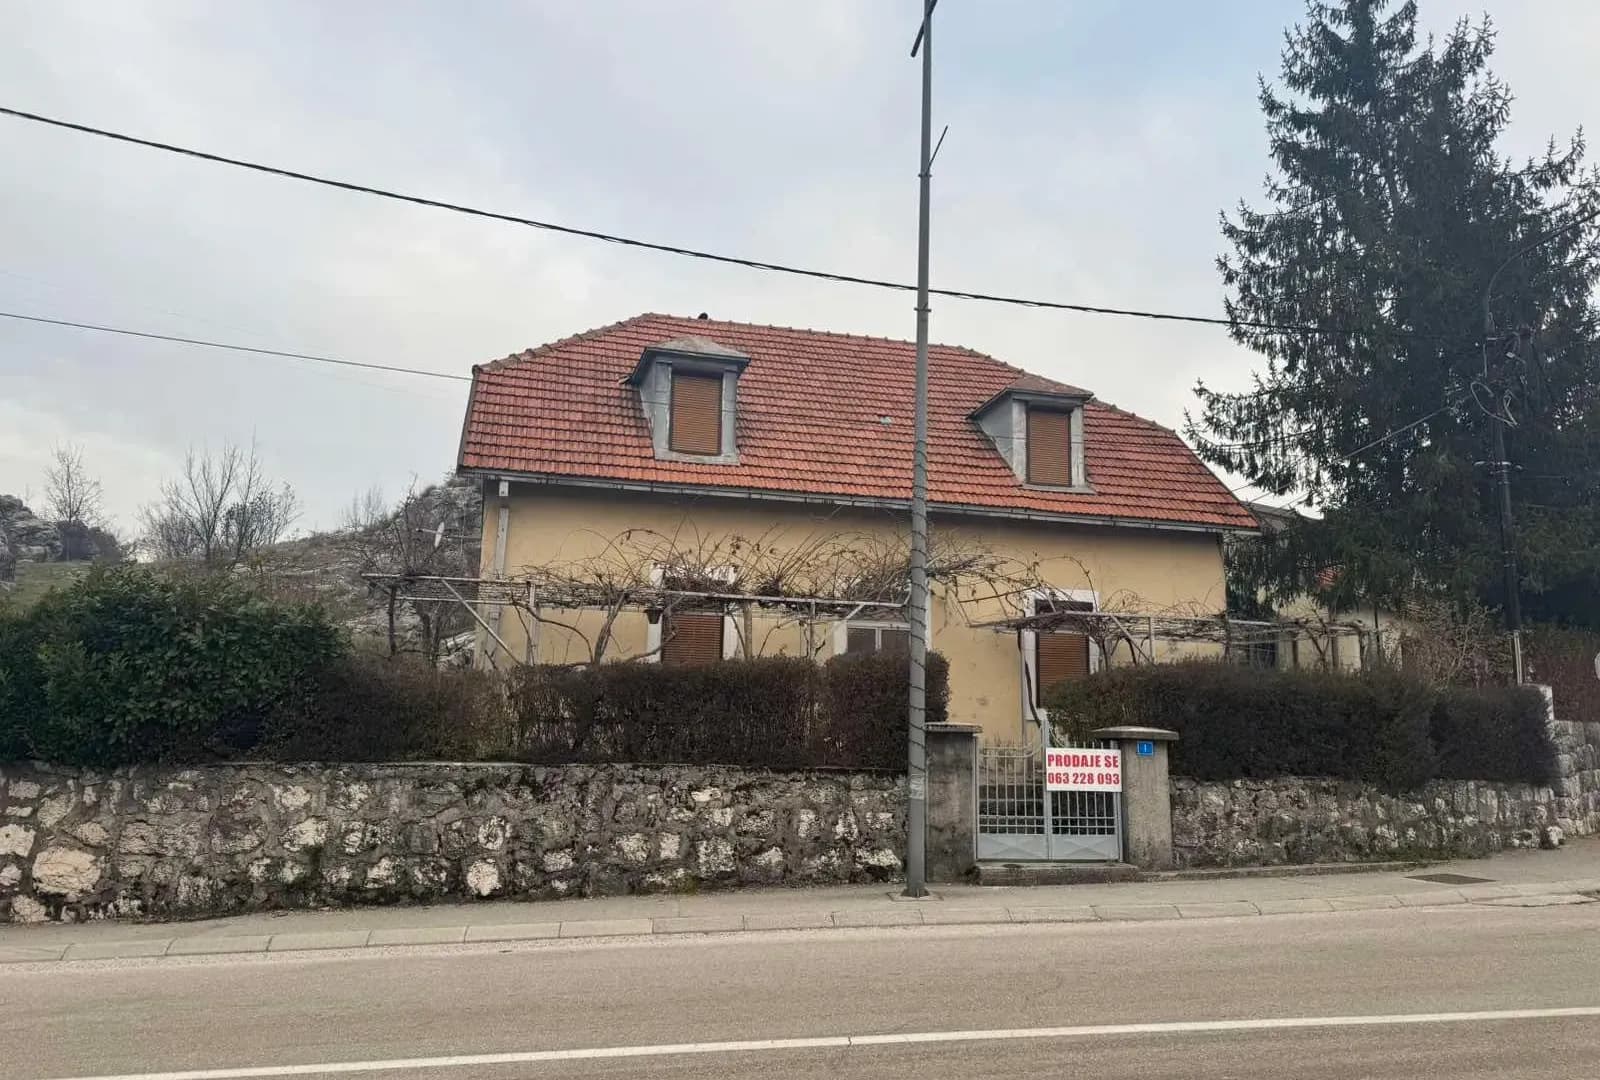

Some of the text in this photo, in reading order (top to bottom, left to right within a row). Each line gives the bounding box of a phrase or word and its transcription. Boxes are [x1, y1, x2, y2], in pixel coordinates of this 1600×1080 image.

[1047, 754, 1119, 768] PRODAJE SE
[1047, 772, 1120, 785] 063 228 093
